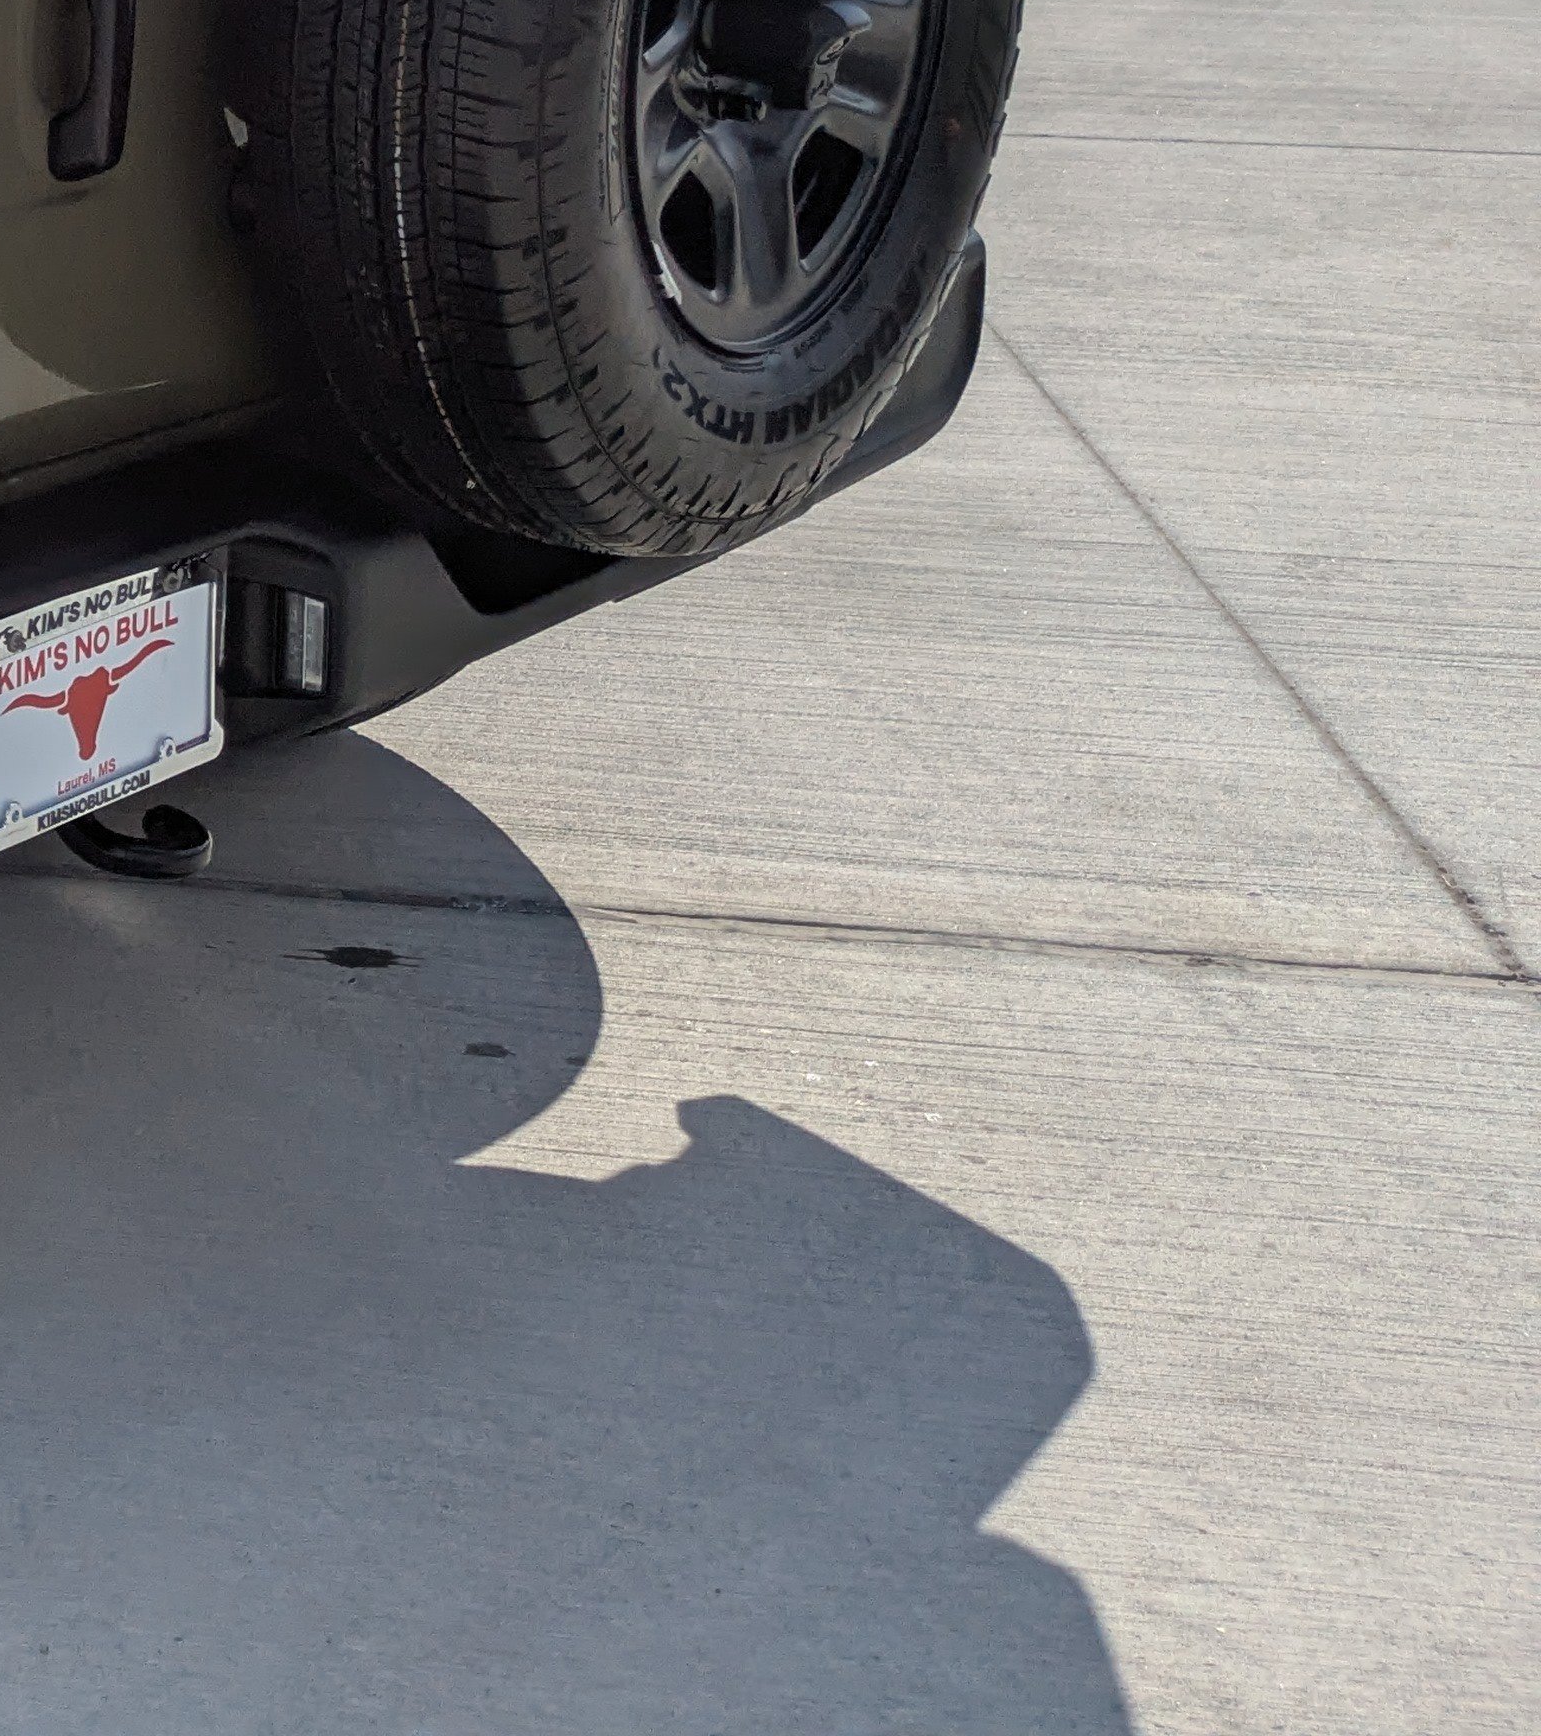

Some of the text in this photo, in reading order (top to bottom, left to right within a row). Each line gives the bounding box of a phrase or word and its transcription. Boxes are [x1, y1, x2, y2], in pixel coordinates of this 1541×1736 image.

[663, 360, 755, 445] HTX2
[26, 570, 164, 640] KIM'S NO BULL
[75, 625, 110, 663] NO
[116, 600, 179, 646] BULL
[37, 770, 151, 832] KIMSNOBULL.COM
[57, 757, 117, 796] Laurel, MS
